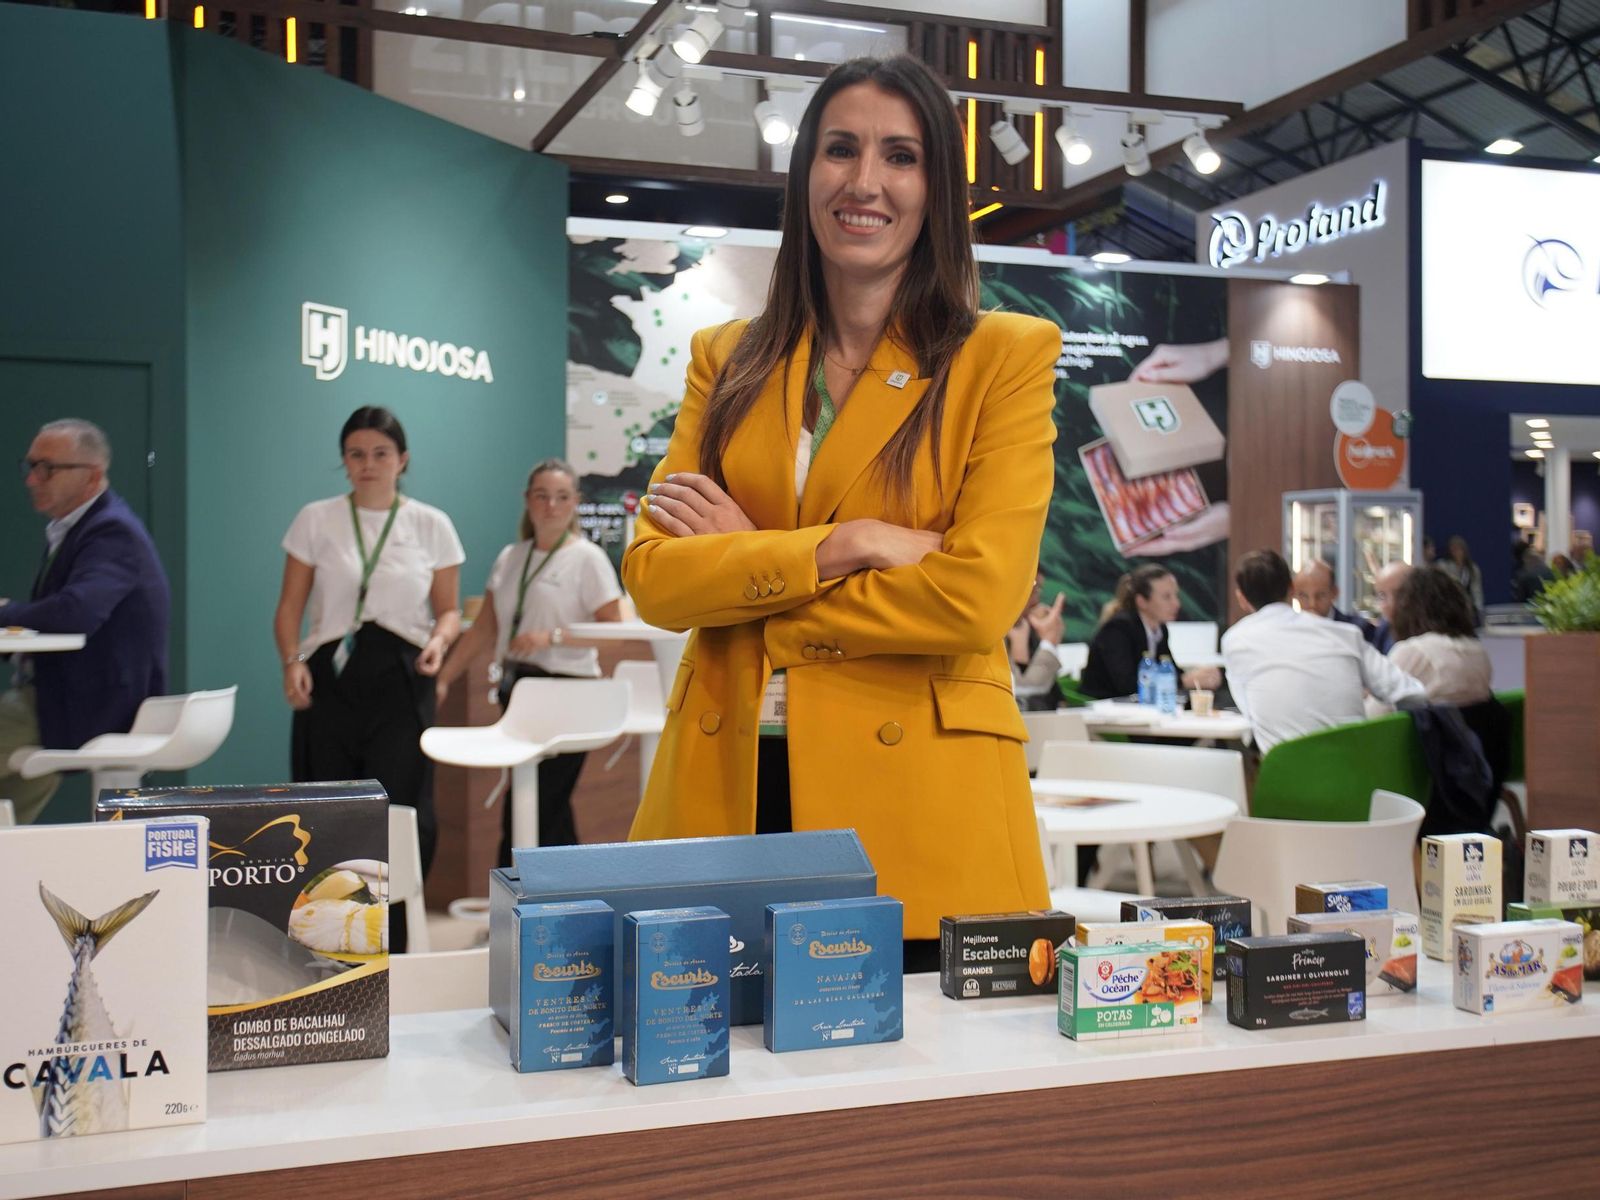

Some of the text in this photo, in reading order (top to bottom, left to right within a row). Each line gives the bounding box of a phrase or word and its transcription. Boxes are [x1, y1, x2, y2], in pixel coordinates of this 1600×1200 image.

[355, 325, 494, 384] HINOJOSA
[148, 830, 196, 841] PORTUGAL
[1455, 885, 1492, 897] SARDINHAS
[963, 935, 999, 946] Mejillones
[963, 945, 1027, 961] Escabeche
[963, 966, 993, 976] GRANDES
[817, 972, 864, 983] NAVAJAS
[1266, 974, 1301, 982] SARDINER
[1101, 983, 1130, 994] Océan
[536, 995, 600, 1006] VENTRESCA
[540, 1006, 567, 1014] BONITO
[1097, 1009, 1133, 1022] POTAS
[233, 1013, 346, 1035] LOMBO DE BACALHAU
[133, 1038, 148, 1048] DE
[233, 1027, 366, 1052] DESSALGADO CONGELADO
[233, 1049, 285, 1062] Gadus morhua
[3, 1050, 170, 1090] CAVALA
